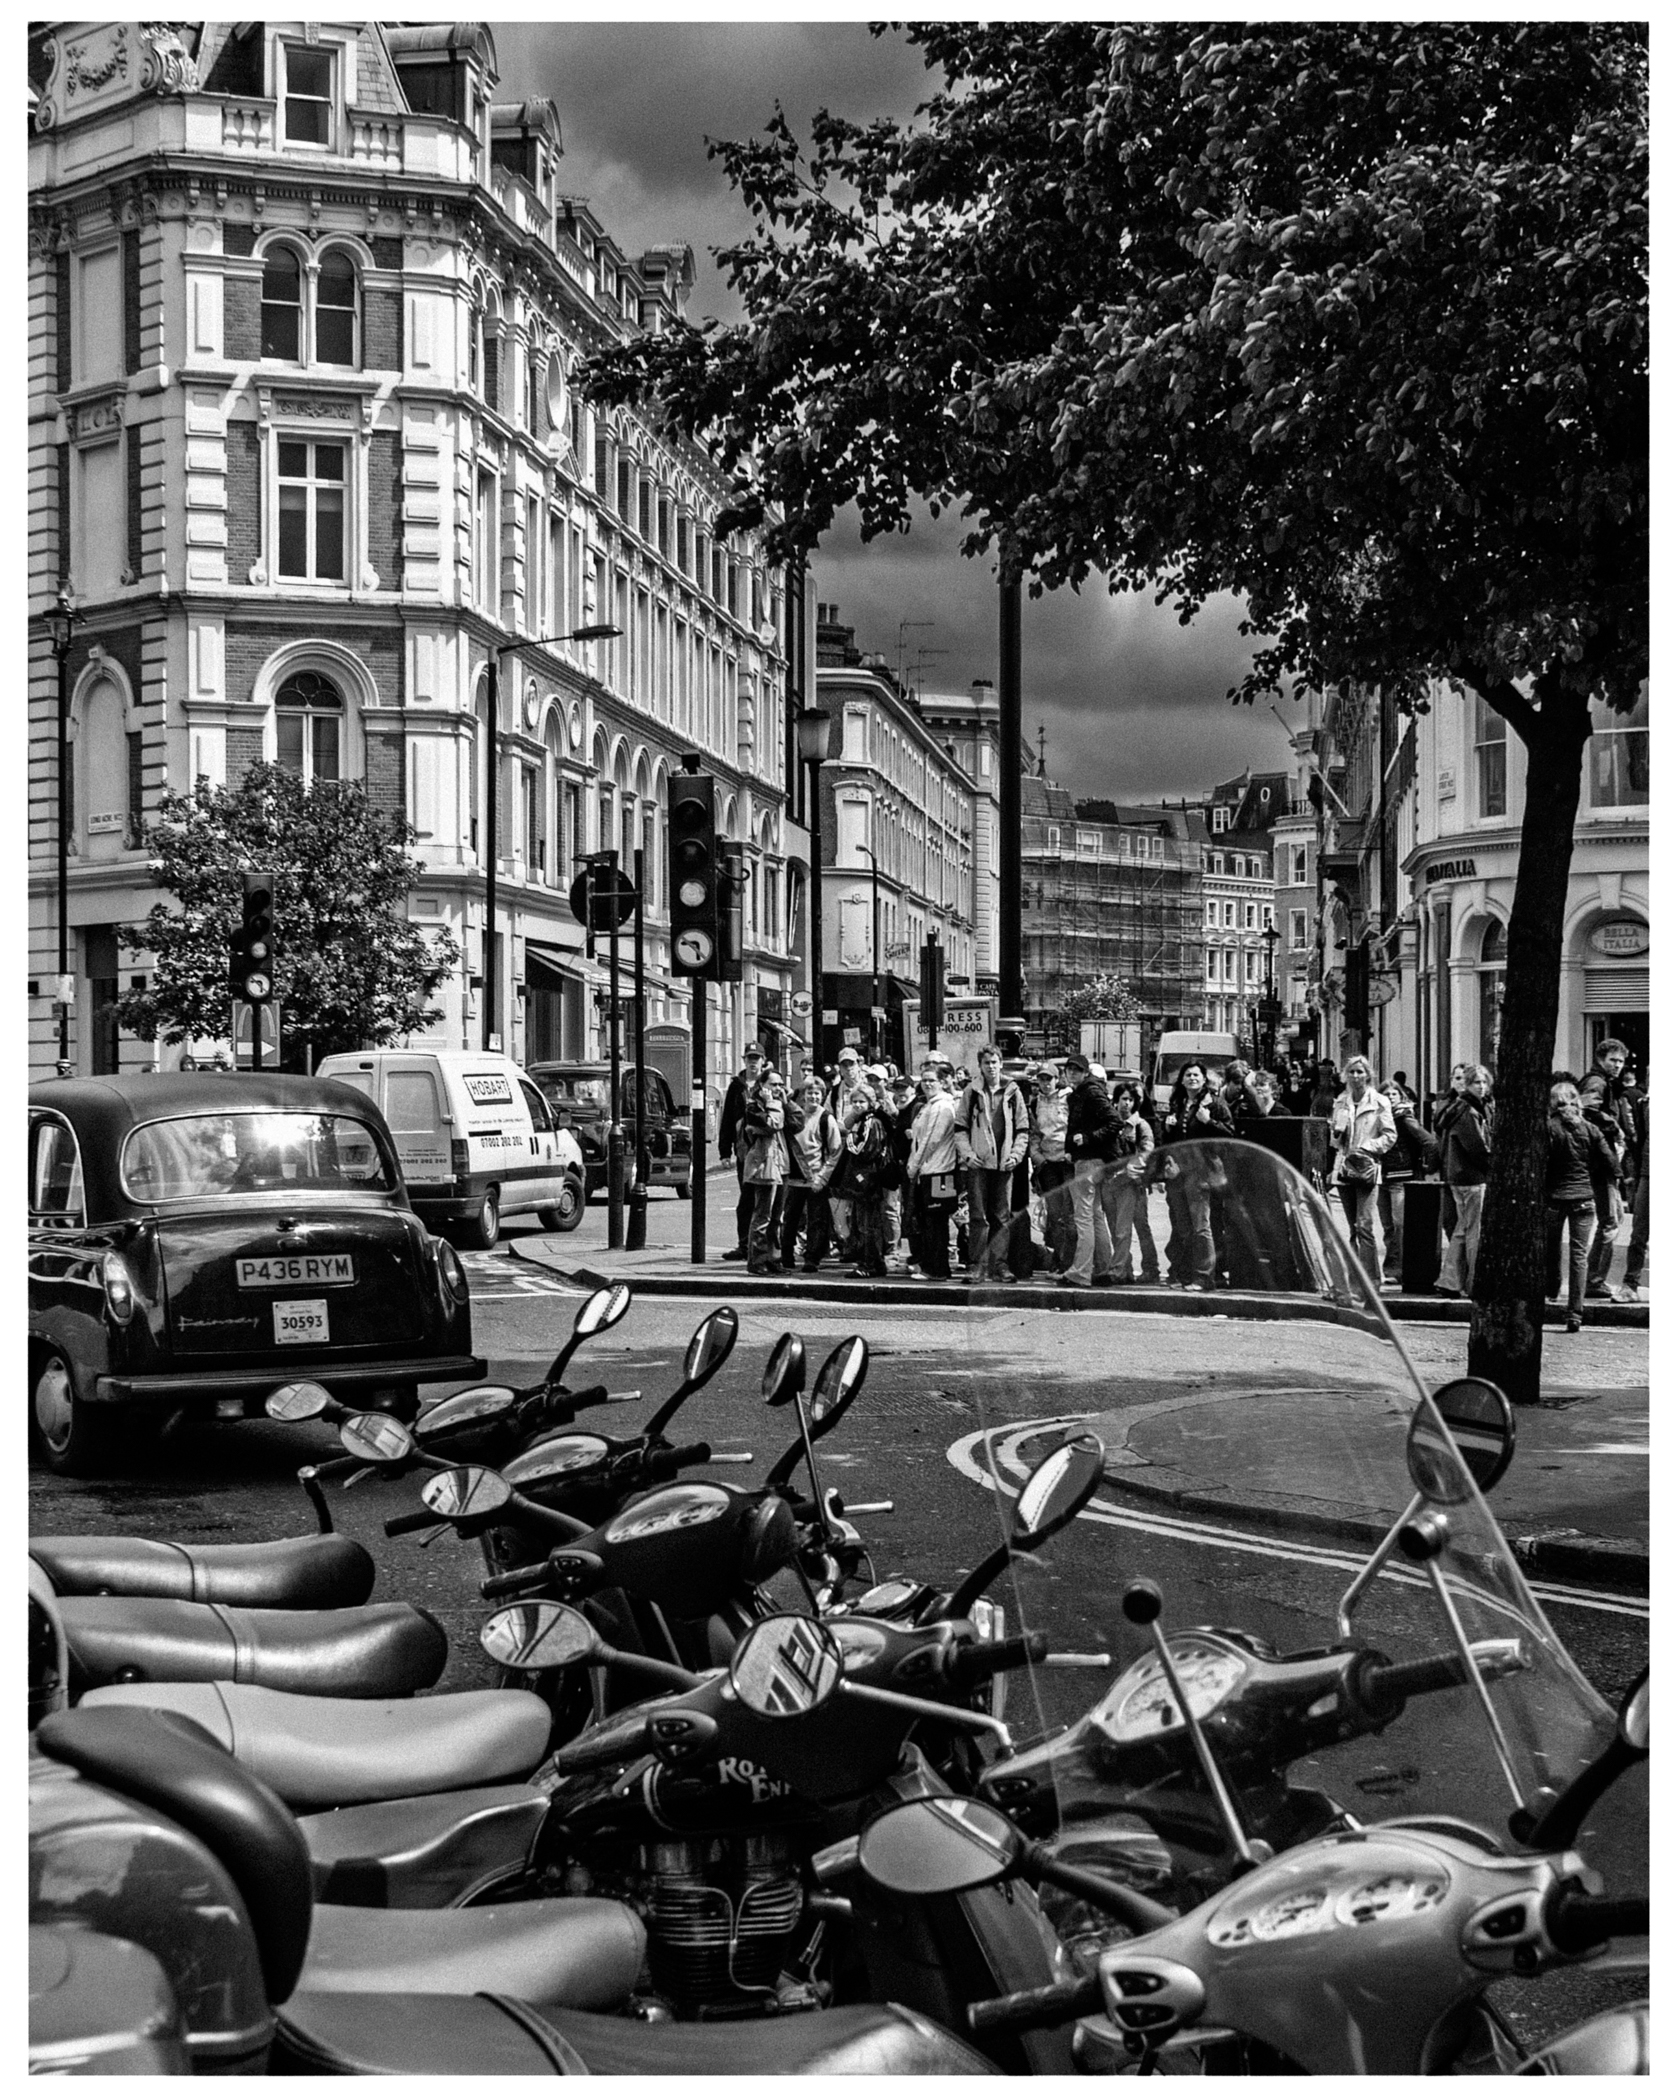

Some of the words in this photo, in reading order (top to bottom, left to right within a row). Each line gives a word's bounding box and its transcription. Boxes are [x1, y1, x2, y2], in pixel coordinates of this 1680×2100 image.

[1604, 928, 1639, 938] BELLA
[1604, 940, 1641, 949] ITALIA
[917, 1012, 982, 1022] ERESS
[917, 1023, 982, 1034] 080-100-600
[470, 1080, 507, 1095] HOBART
[242, 1261, 301, 1281] P436
[306, 1258, 349, 1278] RYM
[281, 1315, 323, 1330] 30593
